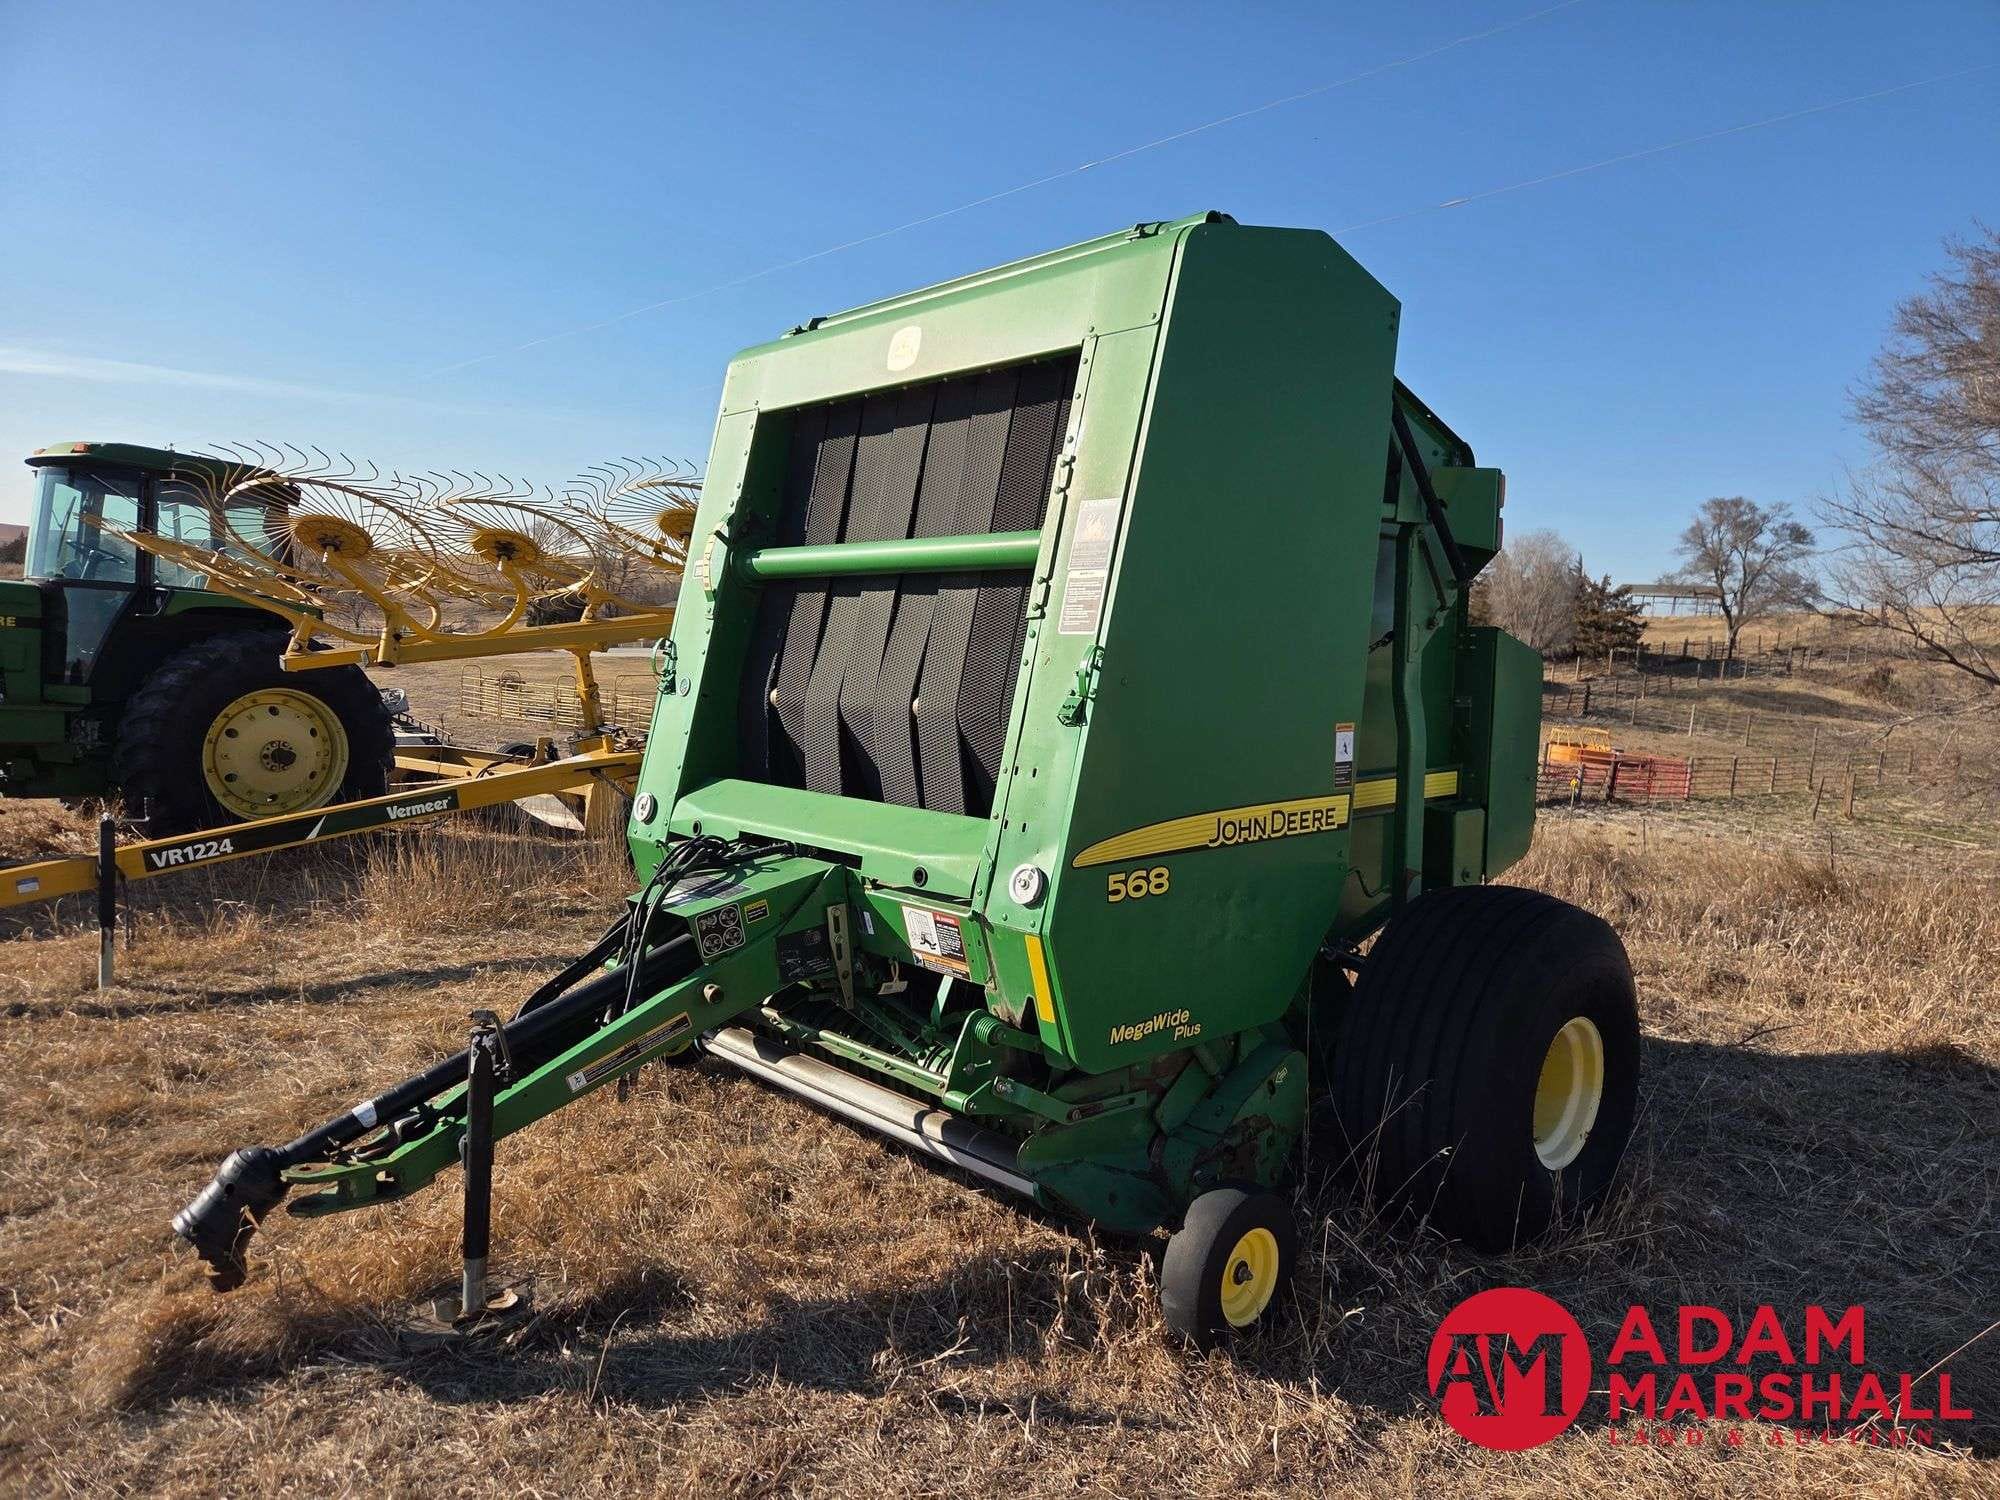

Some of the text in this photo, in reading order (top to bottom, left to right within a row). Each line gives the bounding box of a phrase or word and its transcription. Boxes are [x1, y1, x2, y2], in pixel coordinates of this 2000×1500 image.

[386, 797, 449, 820] Vermeer
[1208, 807, 1337, 847] JOHN DEERE
[151, 838, 234, 868] VR1224
[1107, 866, 1170, 902] 568
[1110, 1008, 1190, 1045] MegaWide
[1174, 1023, 1202, 1041] Plus
